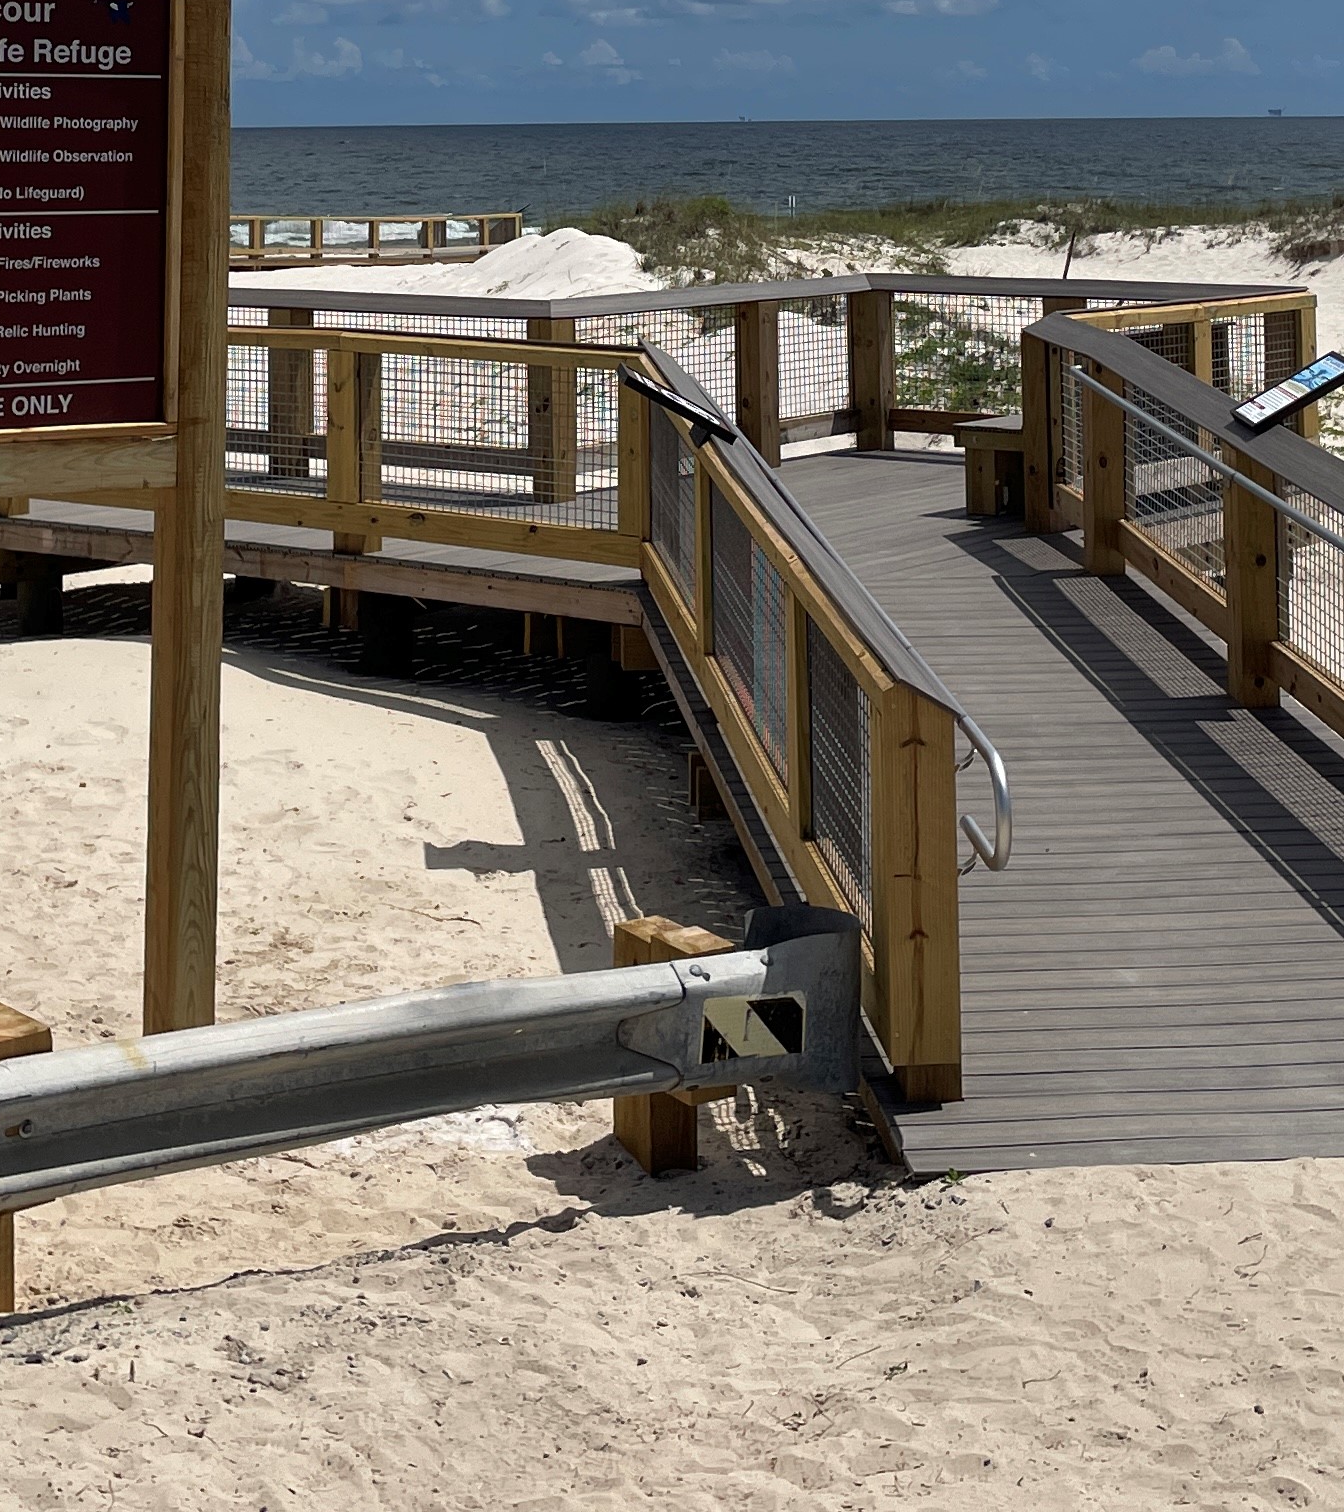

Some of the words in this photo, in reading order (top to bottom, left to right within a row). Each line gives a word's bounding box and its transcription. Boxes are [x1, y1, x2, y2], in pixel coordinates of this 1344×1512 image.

[34, 39, 131, 70] Refuge
[0, 116, 50, 128] Wildlife
[54, 117, 138, 132] Photography
[0, 150, 49, 162] Wildlife
[53, 150, 132, 162] Observation
[16, 186, 84, 201] Lifeguard)
[50, 289, 91, 301] Plants
[33, 323, 85, 337] Hunting
[14, 359, 80, 374] Overnight
[12, 394, 73, 415] ONLY
